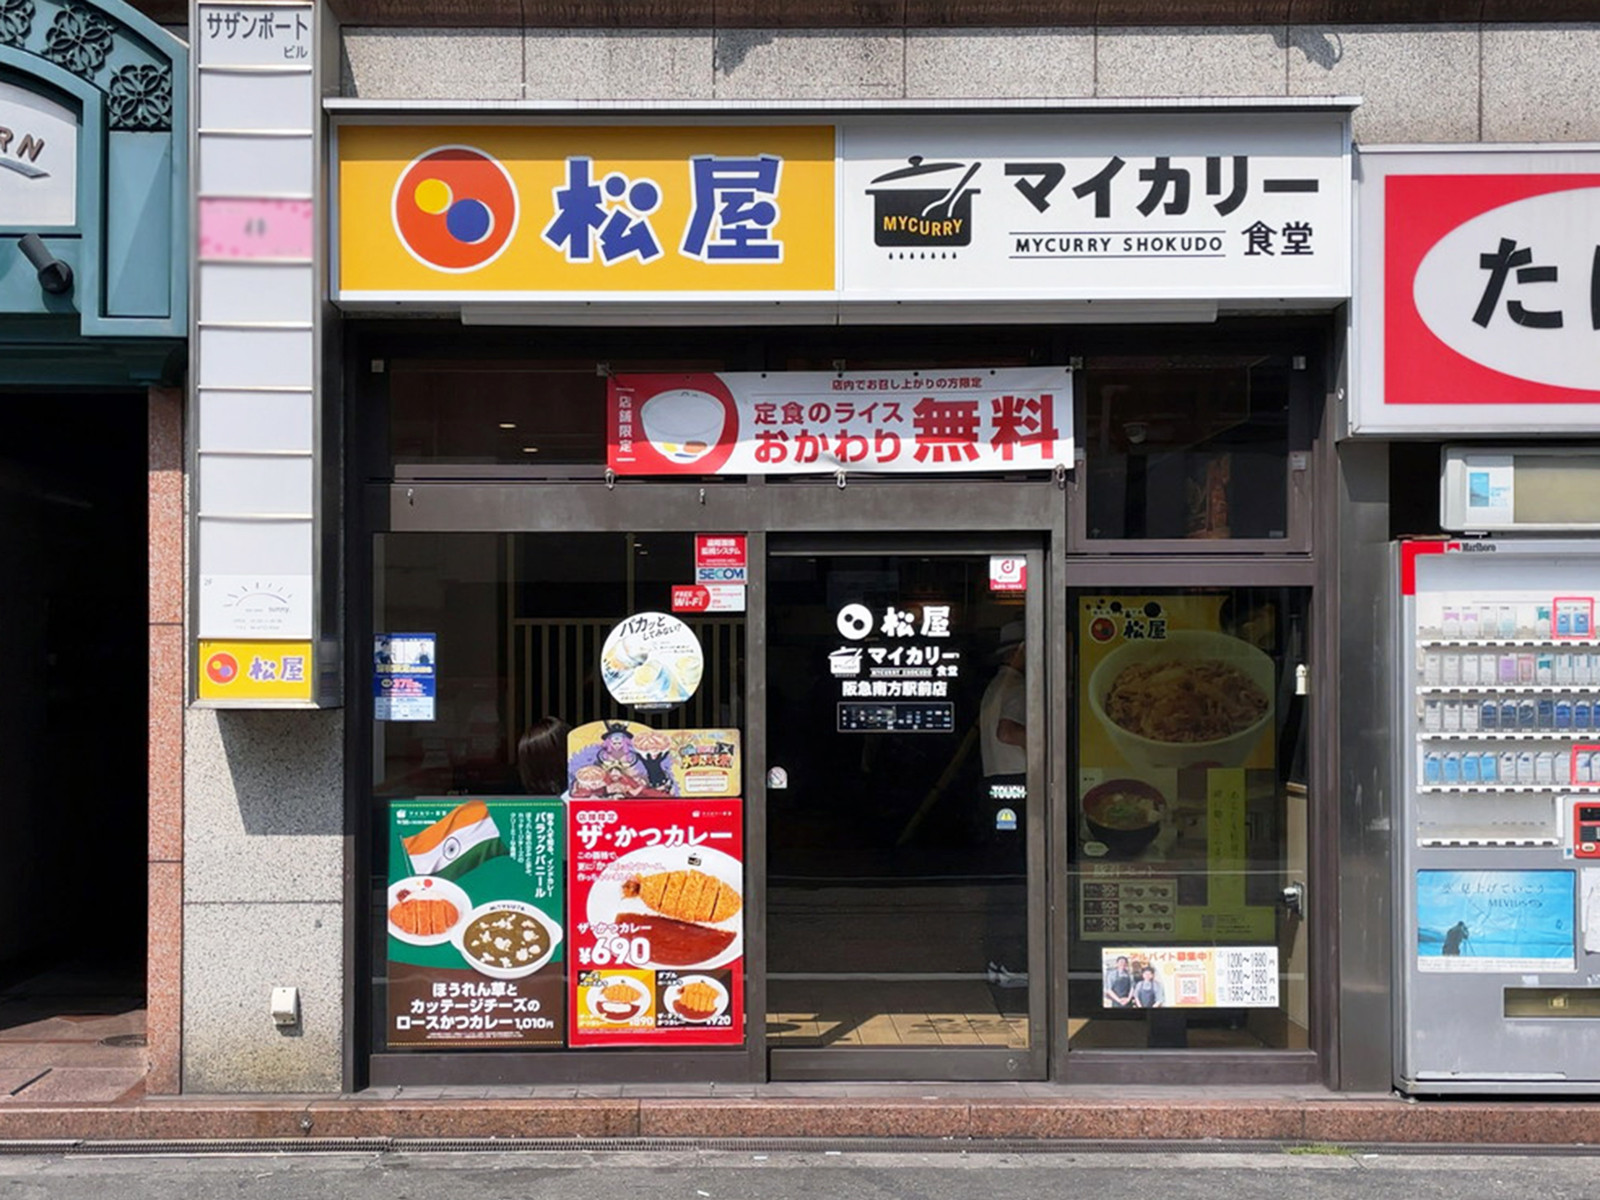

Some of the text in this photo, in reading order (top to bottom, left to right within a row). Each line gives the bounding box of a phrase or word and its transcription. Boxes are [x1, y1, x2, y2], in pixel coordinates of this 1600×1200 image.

[207, 12, 308, 39] サザンポート
[283, 45, 308, 59] ビル
[1004, 154, 1320, 218] マイカリー
[543, 156, 783, 264] 松屋
[883, 215, 963, 237] MYCURRY
[1015, 236, 1222, 253] MYCURRY SHOKUDO
[1241, 220, 1314, 257] 食堂
[1471, 237, 1600, 330] た
[832, 376, 983, 391] 店内でお召し上がりの方限定
[618, 396, 633, 453] 店舗限定
[753, 401, 904, 426] 定食のライス
[912, 393, 1059, 464] 無料
[753, 428, 902, 464] おかわり
[699, 567, 744, 580] SECOM
[880, 606, 951, 637] 松屋
[1122, 619, 1166, 639] 松屋
[867, 646, 960, 666] マイカリー
[249, 657, 303, 681] 松屋
[841, 680, 949, 697] 阪急南方駅前店
[578, 812, 617, 822] 店舗限定
[576, 822, 732, 850] ザ・かつカレー
[578, 937, 650, 965] ¥690
[432, 982, 518, 997] ほうれん草と
[410, 998, 541, 1013] カッテージチーズの
[396, 1015, 513, 1030] ロースかつカレー
